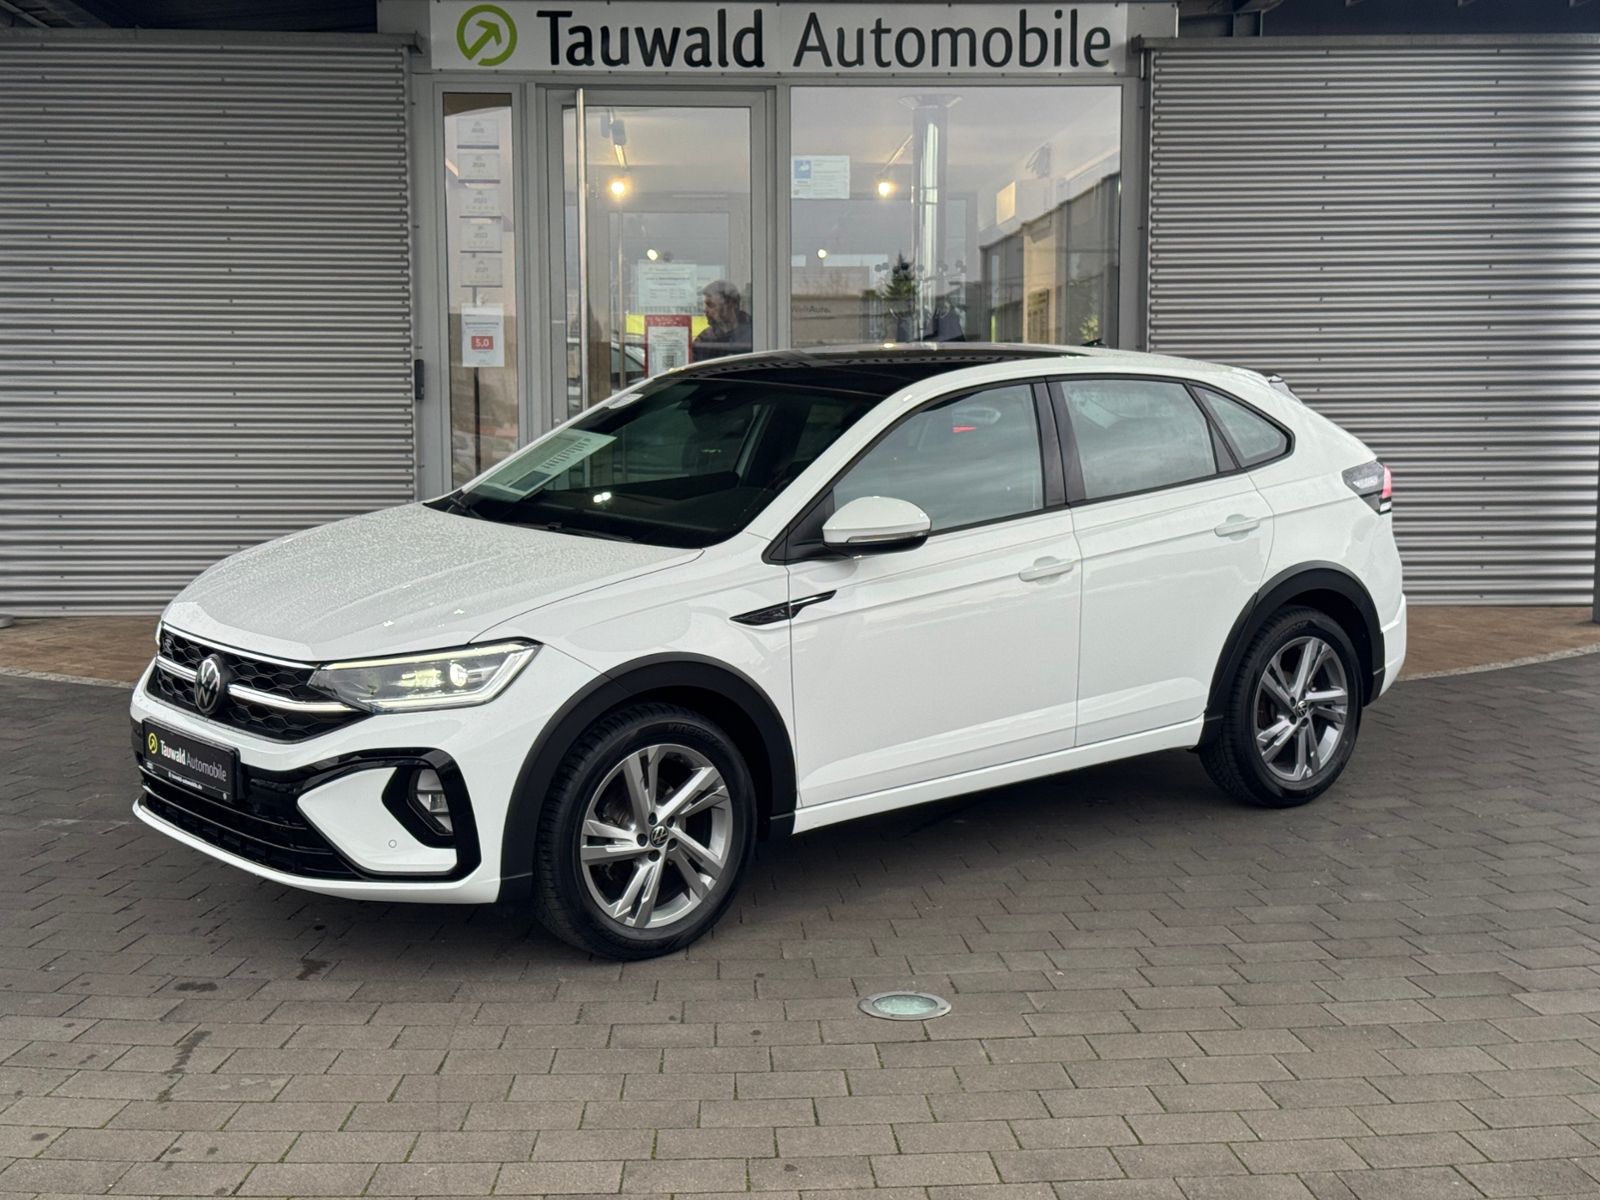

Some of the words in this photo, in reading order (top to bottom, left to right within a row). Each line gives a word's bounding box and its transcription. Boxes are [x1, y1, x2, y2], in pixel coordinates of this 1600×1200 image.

[536, 8, 765, 68] Tauwald
[793, 8, 1111, 68] Automobile
[475, 338, 490, 348] 5.0
[160, 740, 186, 766] Tauwald
[187, 753, 227, 782] Automobile
